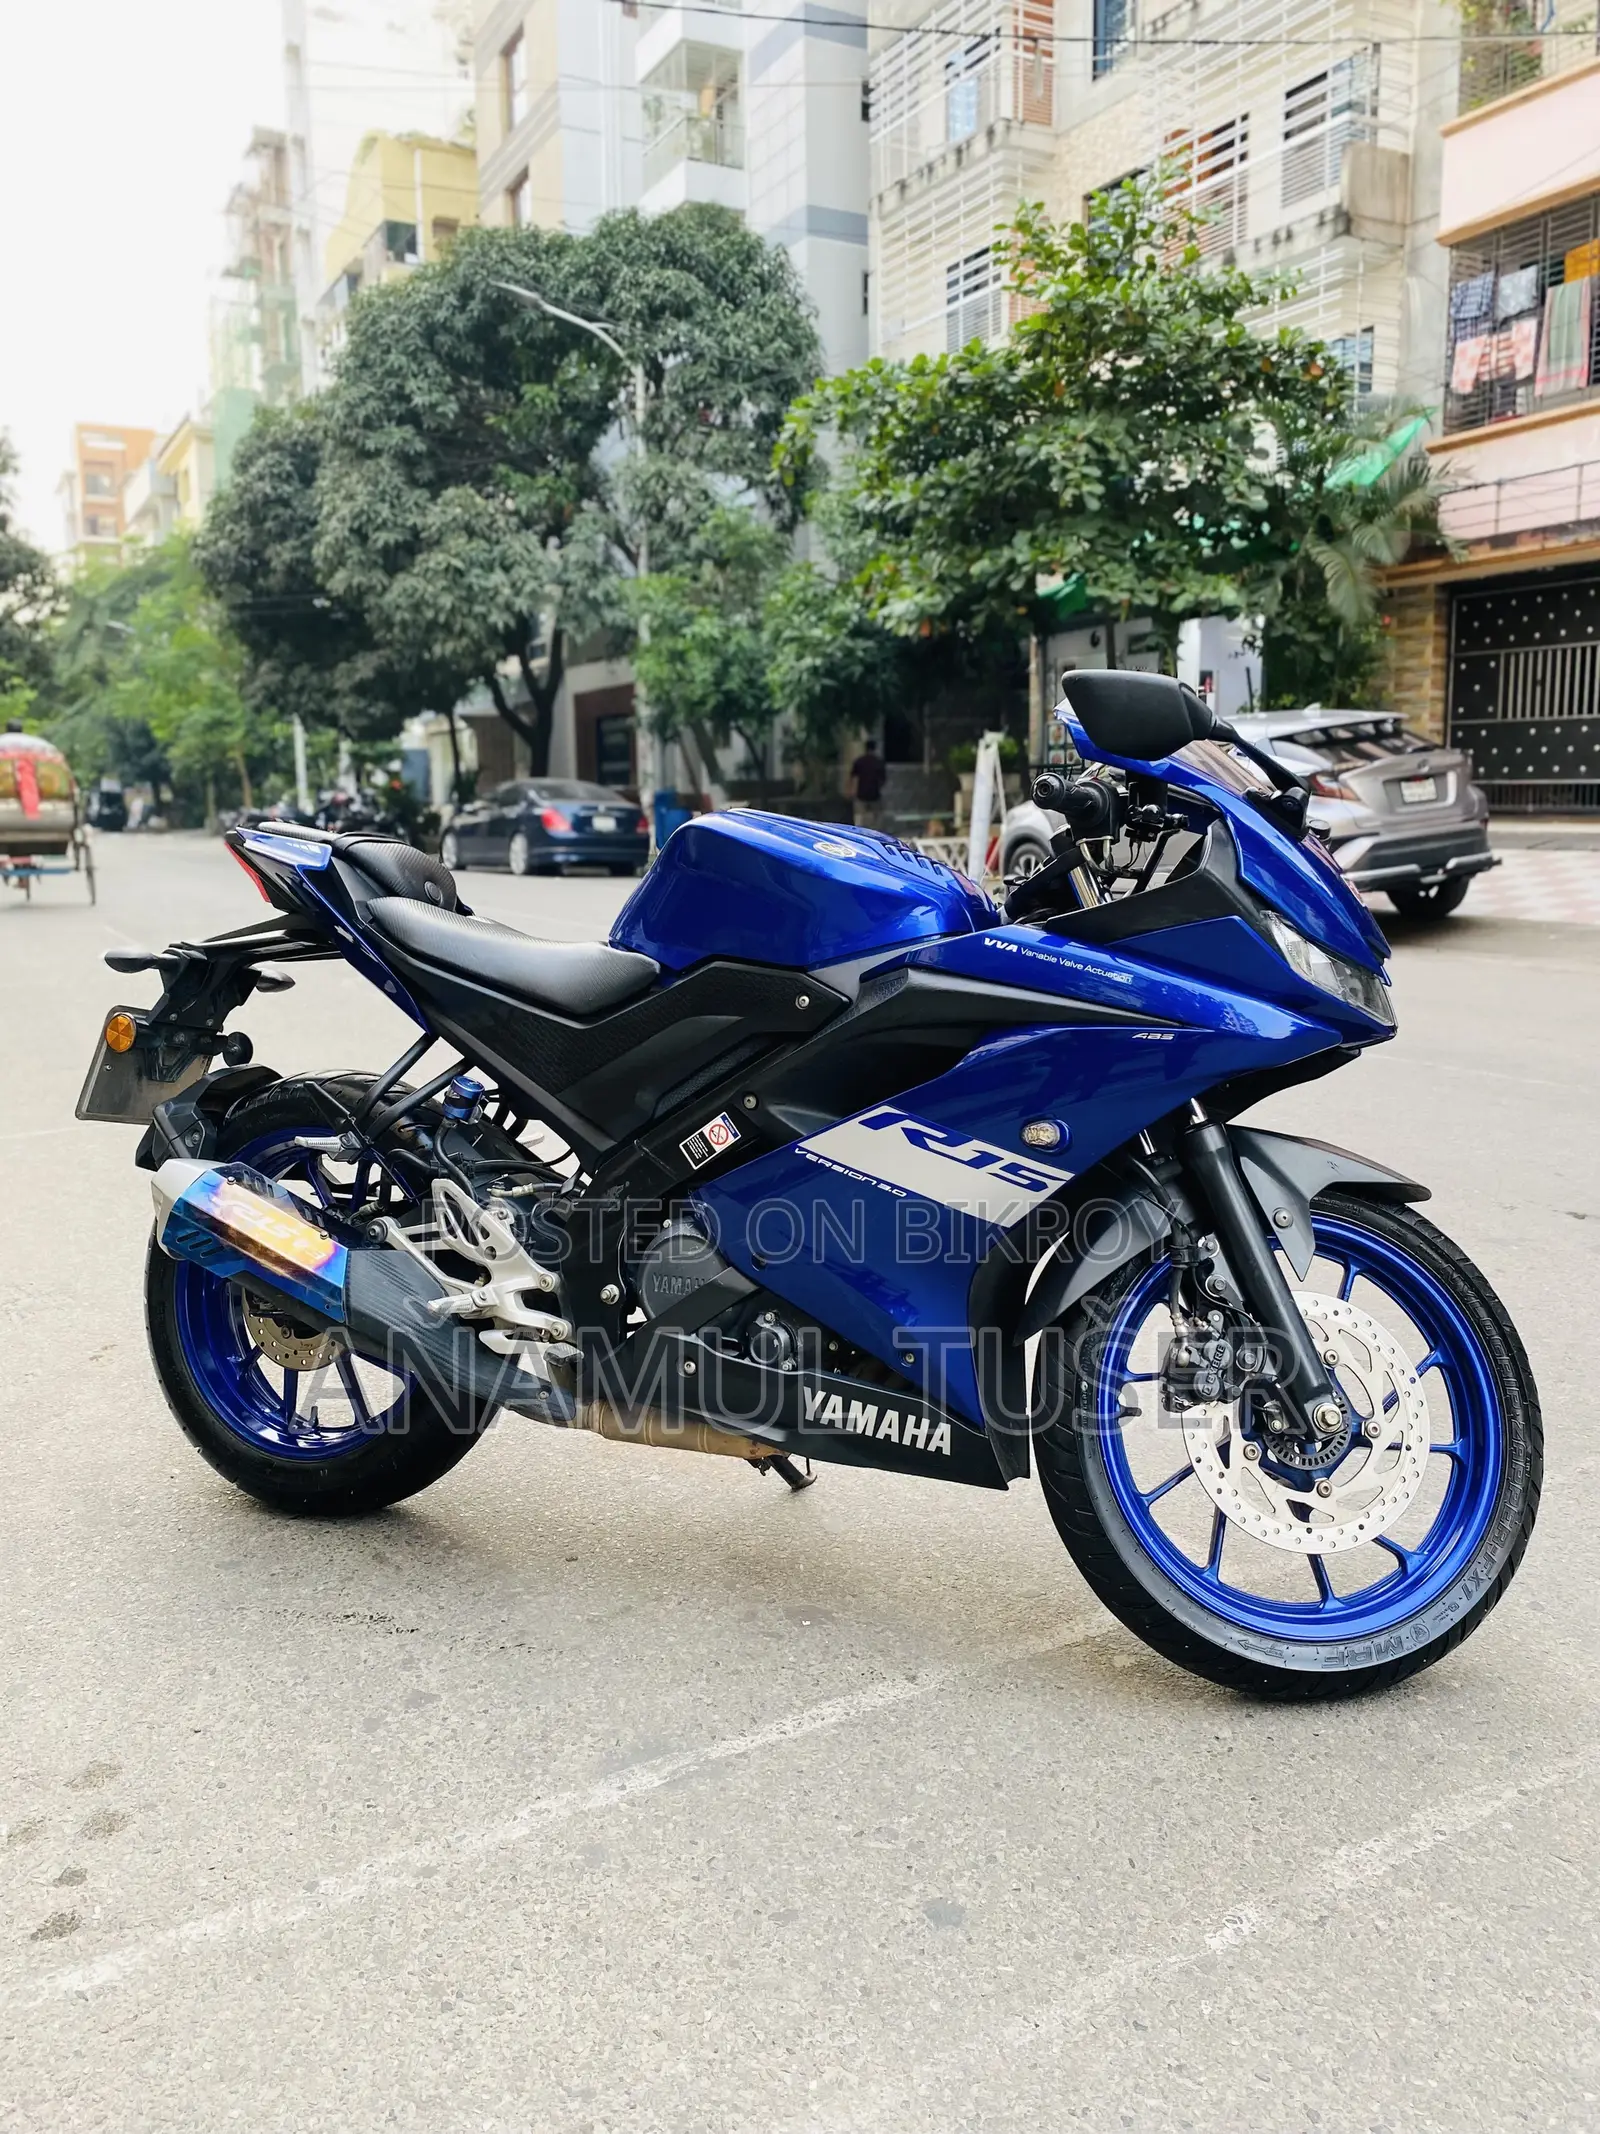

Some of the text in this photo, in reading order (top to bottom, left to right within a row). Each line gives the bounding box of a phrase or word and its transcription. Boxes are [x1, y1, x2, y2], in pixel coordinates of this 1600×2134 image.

[984, 937, 1133, 985] VVA Variable Valve Actuation
[1131, 1032, 1175, 1041] ABS
[877, 1182, 908, 1198] 3.0
[651, 1272, 705, 1295] YAMA
[803, 1386, 951, 1456] YAMAHA
[1321, 1634, 1404, 1669] MRF
